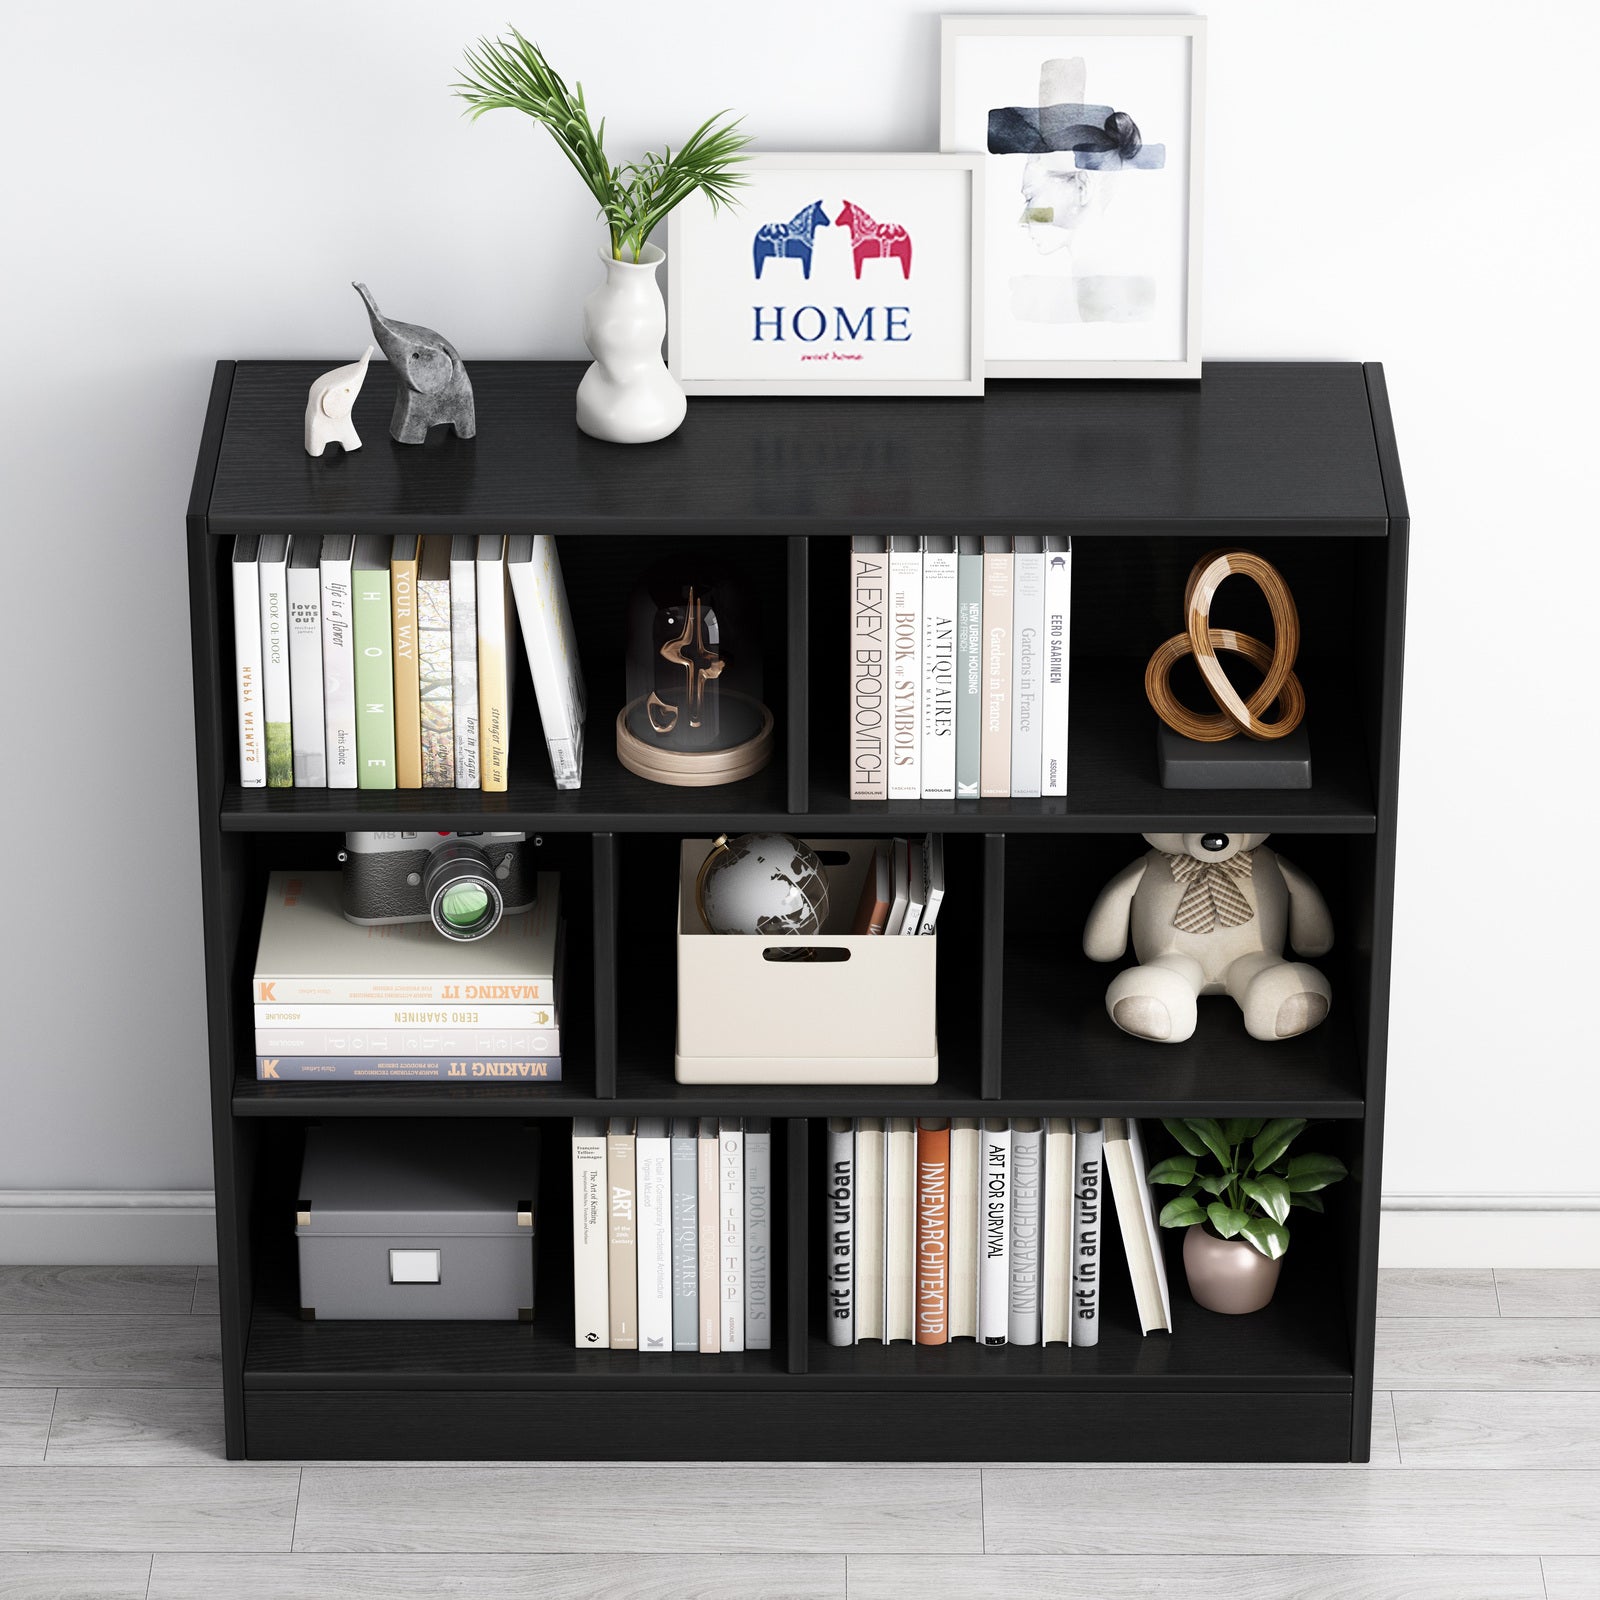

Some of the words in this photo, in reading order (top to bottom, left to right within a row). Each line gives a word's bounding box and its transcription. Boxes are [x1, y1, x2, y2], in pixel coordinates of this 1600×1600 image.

[752, 306, 912, 342] HOME
[325, 582, 347, 598] life
[331, 600, 345, 608] is
[396, 571, 411, 620] YOUR
[856, 560, 882, 642] ALEXEY
[895, 591, 905, 608] THE
[331, 610, 342, 618] a
[969, 602, 979, 622] NEW
[1051, 614, 1063, 637] EERO
[326, 617, 348, 648] flower
[397, 625, 413, 660] WAY
[895, 612, 915, 661] BOOK
[968, 624, 979, 653] URBAN
[990, 627, 1006, 676] Gardens
[1021, 627, 1036, 676] Gardens
[1050, 640, 1062, 684] SAARINEN
[362, 592, 387, 768] HOME
[895, 665, 904, 677] OF
[932, 616, 952, 737] ANTIQUAIRES
[968, 656, 978, 695] HOUSING
[990, 678, 1004, 690] in
[1021, 679, 1035, 690] in
[466, 716, 478, 735] love
[488, 707, 500, 744] stronger
[855, 650, 882, 784] BRODOVITCH
[894, 680, 915, 766] SYMBOLS
[990, 692, 1004, 733] France
[1020, 693, 1035, 733] France
[337, 729, 349, 744] chris
[467, 738, 475, 746] in
[338, 745, 349, 766] choice
[464, 749, 476, 779] prague
[492, 746, 504, 767] than
[492, 769, 502, 783] sin
[441, 985, 460, 999] IT
[465, 985, 540, 999] MAKING
[265, 1012, 301, 1020] ASSOULINE
[394, 1012, 448, 1022] SAARINEN
[451, 1012, 479, 1023] EERO
[447, 1061, 467, 1076] IT
[472, 1061, 548, 1076] MAKING
[643, 1158, 652, 1181] Virginia
[656, 1158, 664, 1176] Detail
[989, 1144, 1005, 1168] ART
[590, 1170, 598, 1182] The
[590, 1182, 598, 1193] Art
[988, 1172, 1005, 1198] FOR
[612, 1186, 632, 1221] ART
[643, 1182, 652, 1207] McLeod
[654, 1184, 664, 1227] Contemporary
[828, 1160, 851, 1224] urban
[1075, 1160, 1098, 1224] urban
[588, 1200, 598, 1225] Knitting
[749, 1185, 766, 1228] BOOK
[987, 1202, 1005, 1259] SURVIVAL
[1013, 1144, 1038, 1314] INNENARCHITEKTUR
[656, 1228, 664, 1262] Residential
[679, 1193, 696, 1298] ANTIQUAIRES
[702, 1225, 716, 1280] BORDEAUX
[833, 1230, 850, 1257] an
[920, 1162, 945, 1334] INNENARCHITEKTUR
[1080, 1230, 1096, 1257] an
[656, 1263, 664, 1299] Architecture
[749, 1244, 767, 1321] SYMBOLS
[828, 1260, 850, 1284] in
[1073, 1260, 1096, 1284] in
[829, 1288, 850, 1319] art
[1077, 1288, 1096, 1319] art
